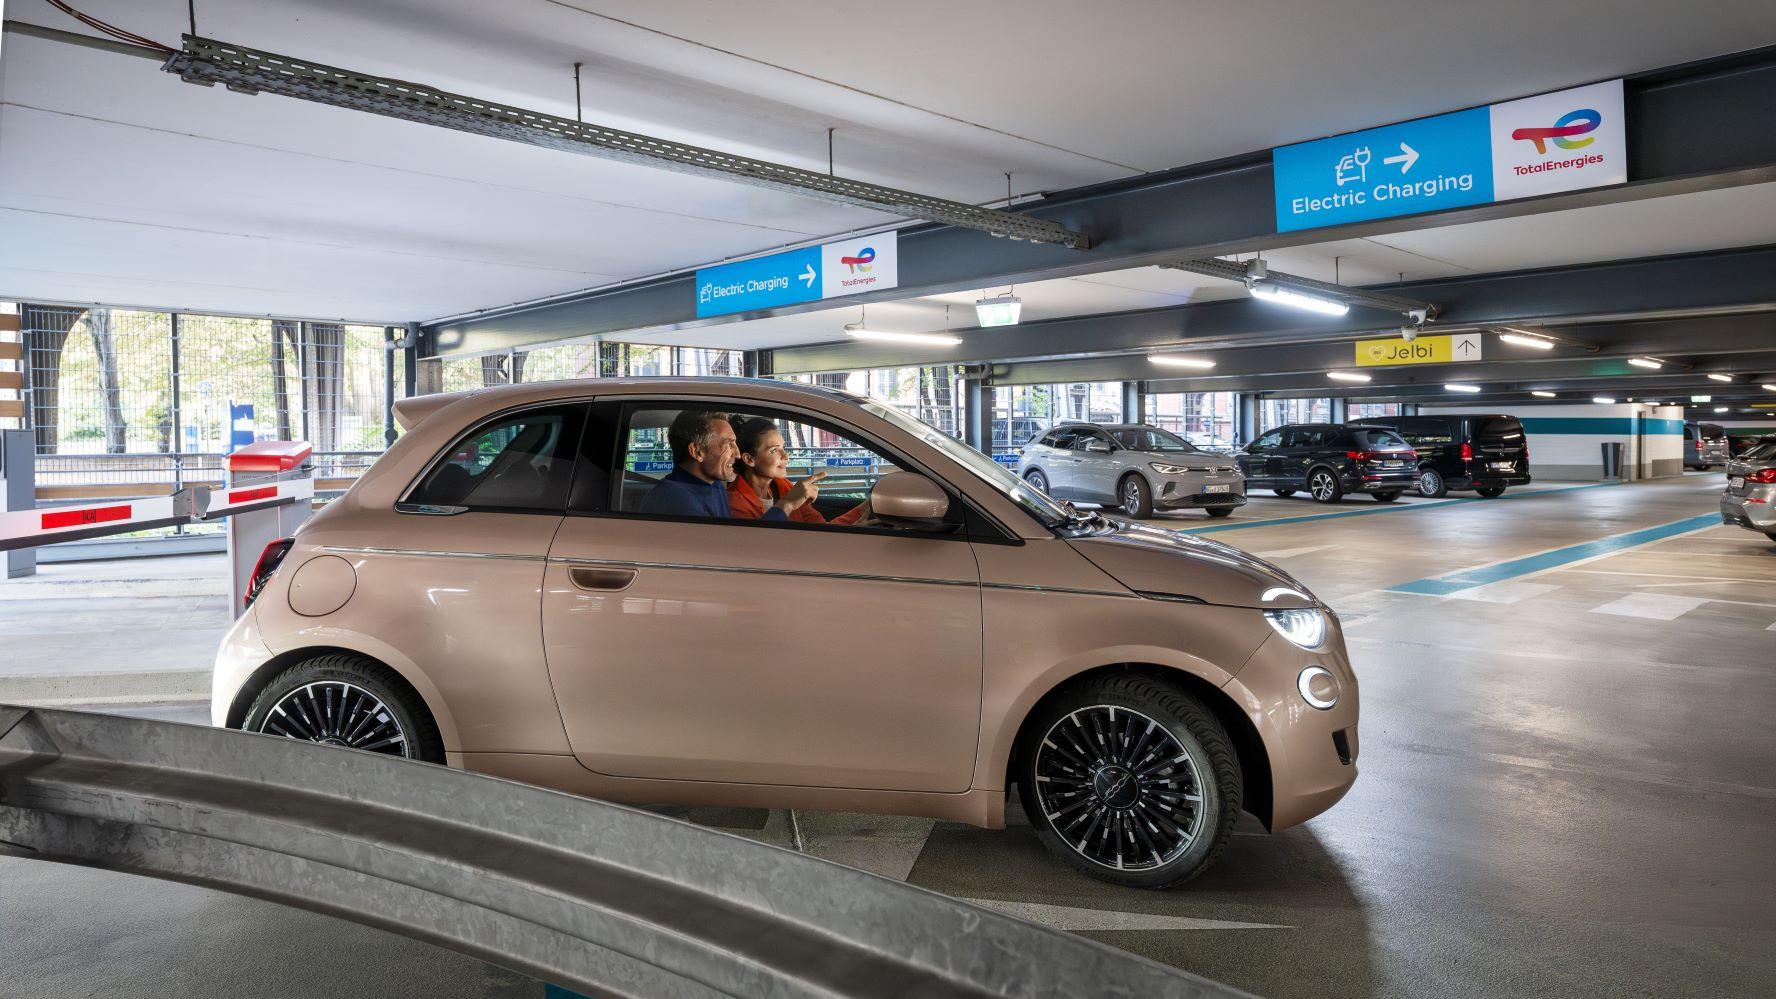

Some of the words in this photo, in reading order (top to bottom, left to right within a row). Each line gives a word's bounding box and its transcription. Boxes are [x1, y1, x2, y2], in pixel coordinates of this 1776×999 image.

[1513, 153, 1605, 176] TotalEnergies
[1292, 189, 1367, 214] Electric
[1373, 172, 1474, 201] Charging
[713, 283, 745, 298] Electric
[747, 276, 789, 292] Charging
[1387, 343, 1433, 360] Jelbi
[652, 462, 674, 470] Parkpl
[840, 458, 864, 466] Parkplatz
